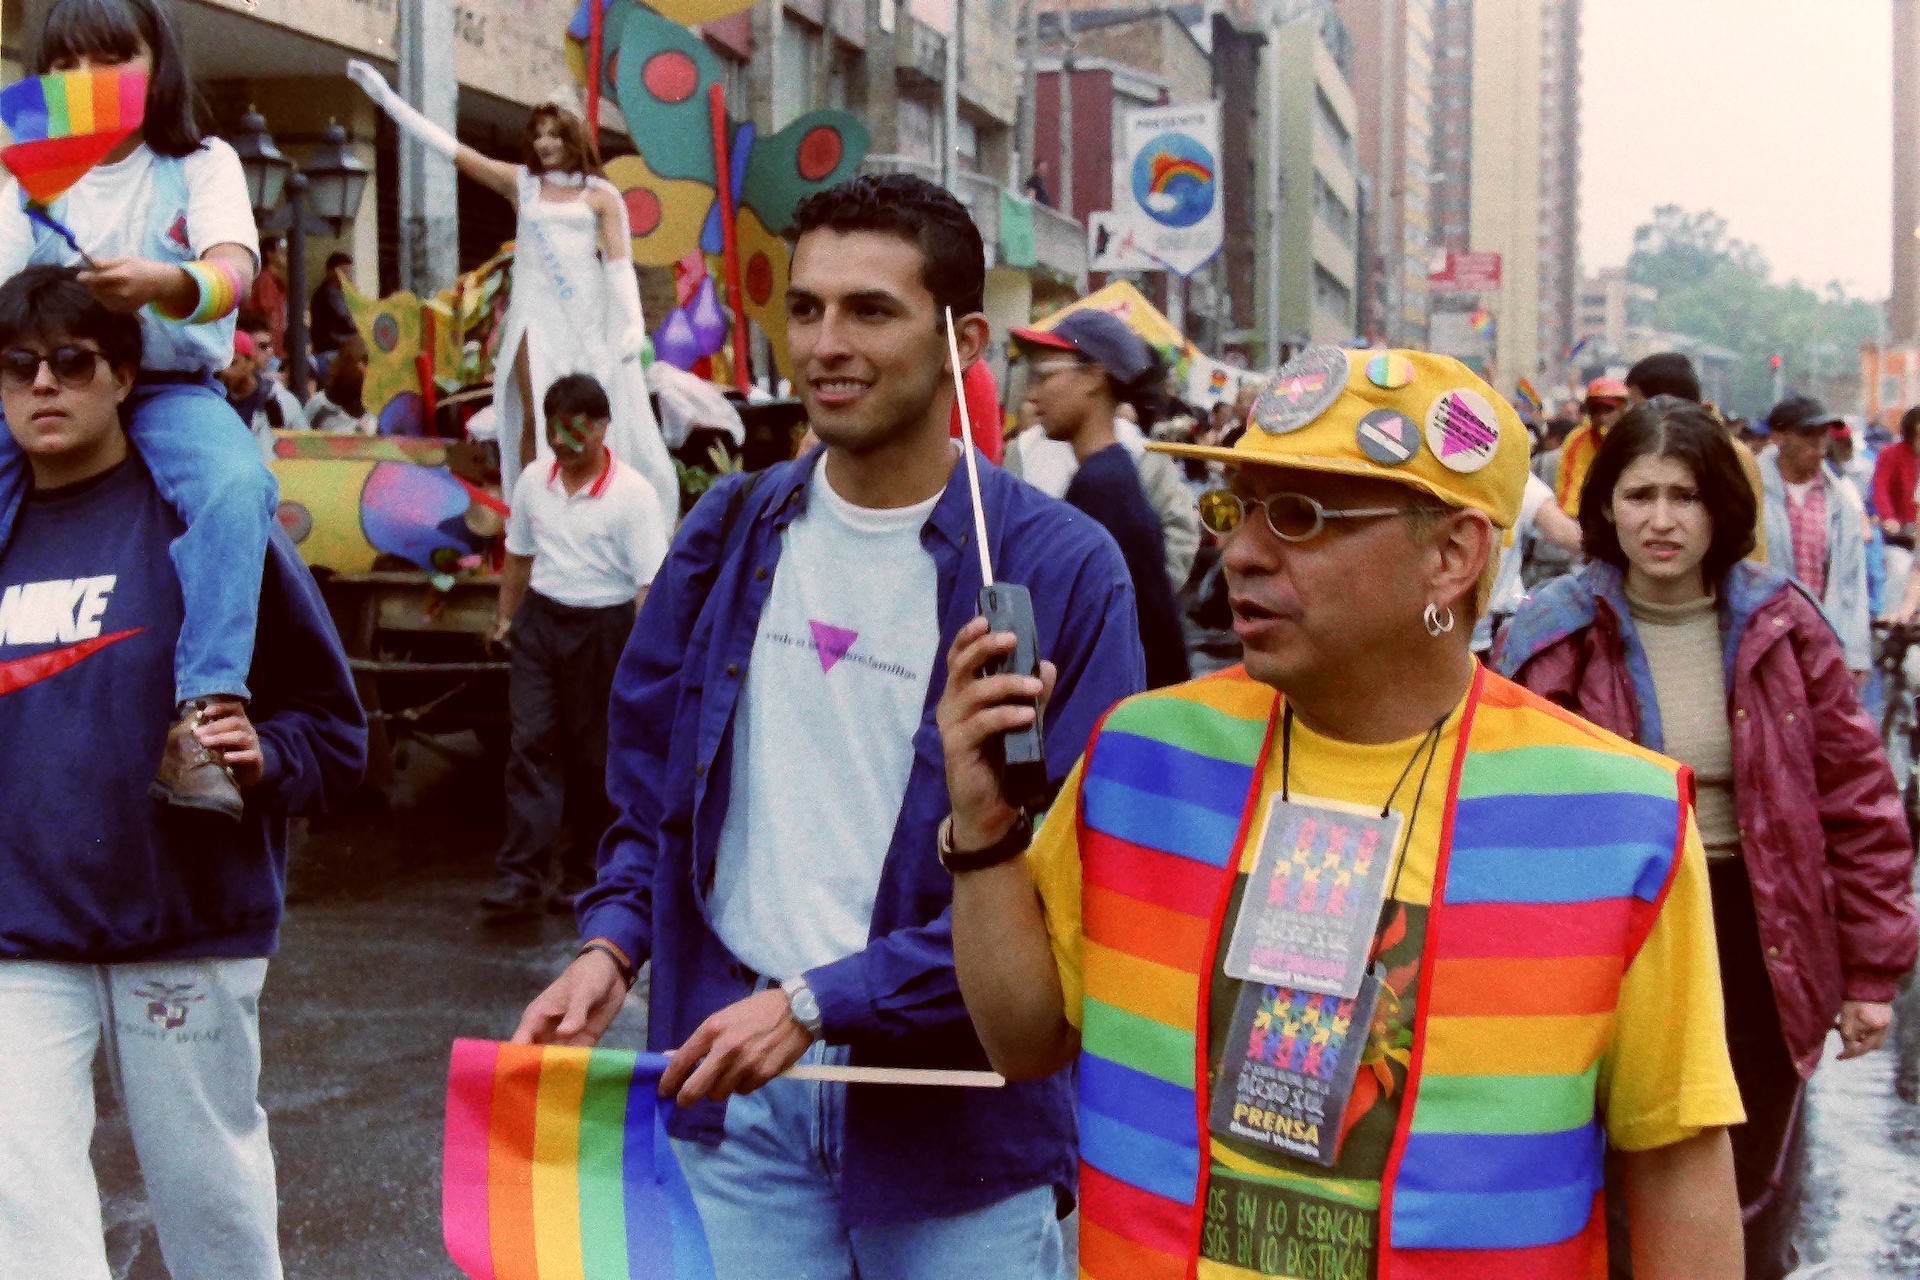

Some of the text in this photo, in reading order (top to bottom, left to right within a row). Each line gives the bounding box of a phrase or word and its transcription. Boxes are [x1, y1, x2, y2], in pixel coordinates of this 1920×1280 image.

[0, 574, 117, 645] NIKE
[1232, 1102, 1319, 1145] PRENSA
[1265, 1199, 1288, 1235] LO
[1258, 1233, 1280, 1276] LO
